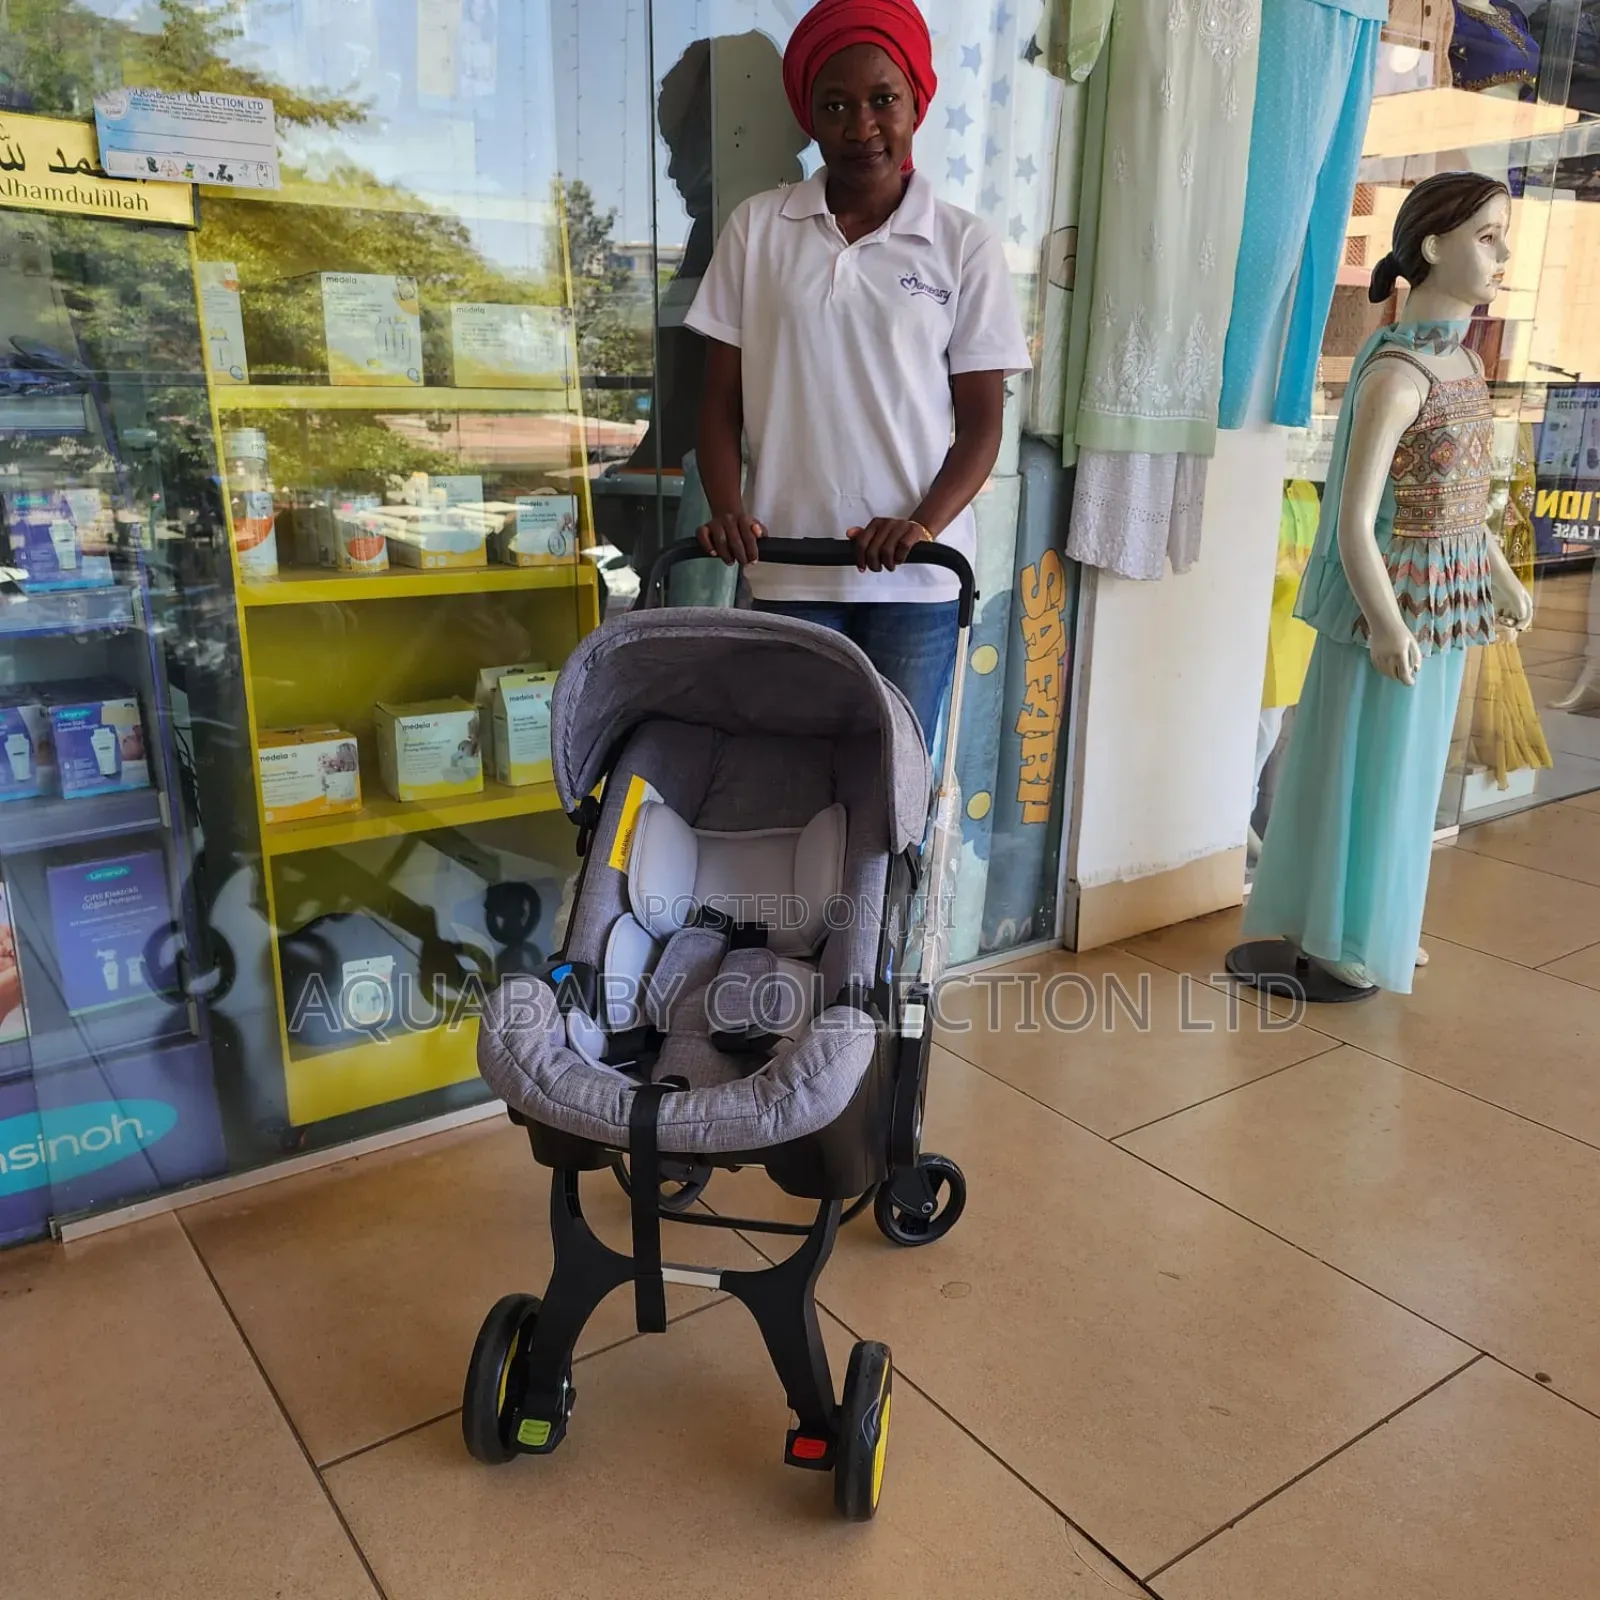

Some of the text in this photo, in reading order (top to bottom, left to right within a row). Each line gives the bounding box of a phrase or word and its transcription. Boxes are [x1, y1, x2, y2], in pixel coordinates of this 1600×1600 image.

[185, 91, 245, 109] COLLECTION
[247, 100, 264, 110] LTD
[326, 276, 357, 285] medela
[456, 305, 485, 315] medela
[1014, 549, 1068, 825] SAFARI
[402, 720, 431, 732] medela
